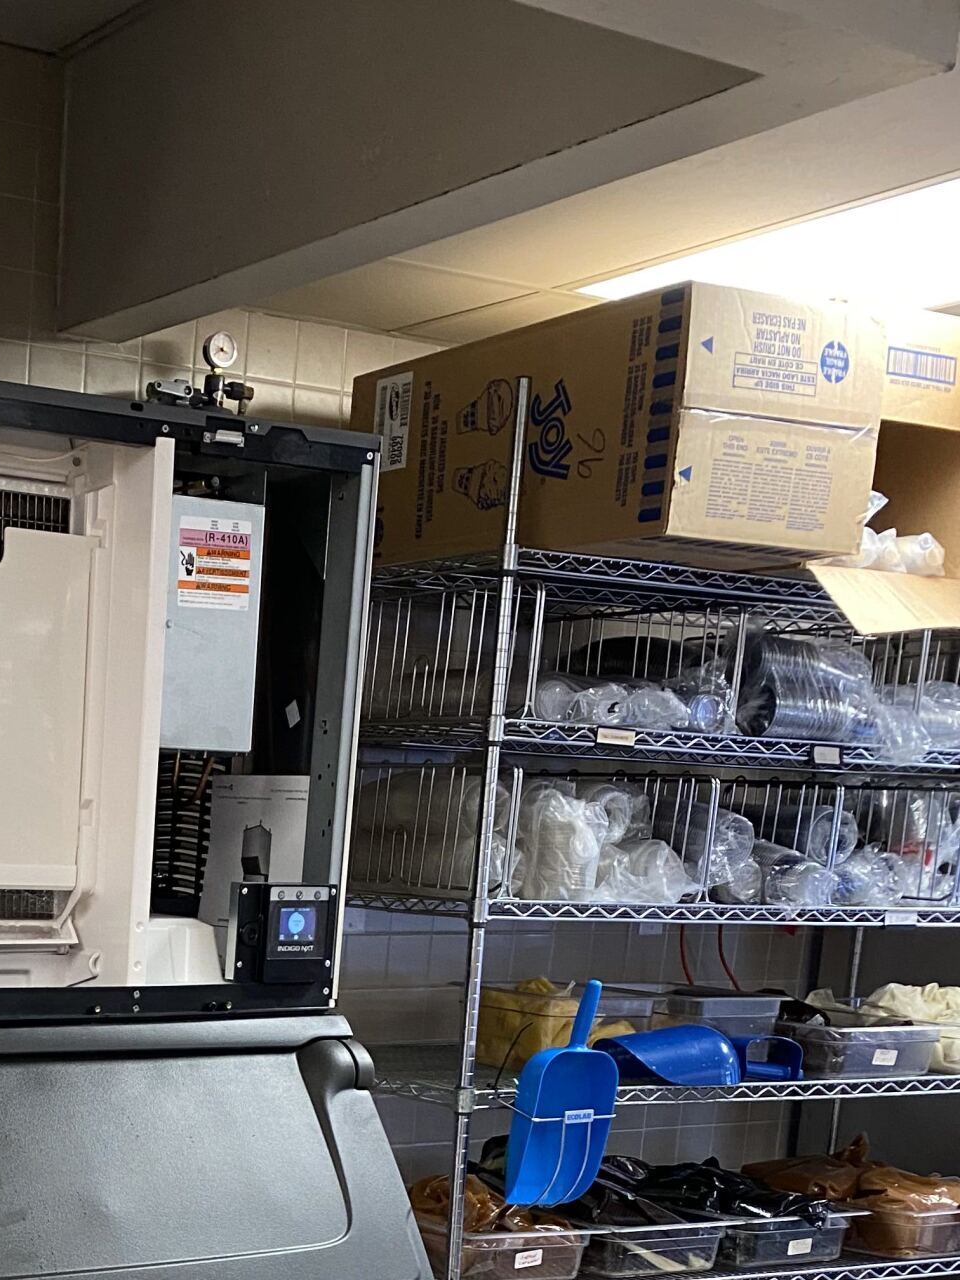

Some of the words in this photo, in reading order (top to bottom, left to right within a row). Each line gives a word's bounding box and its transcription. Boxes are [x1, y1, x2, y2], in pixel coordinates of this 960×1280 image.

[783, 316, 796, 329] PAS
[798, 318, 806, 331] NE
[756, 328, 790, 343] APLASTAR
[791, 333, 801, 345] NO
[753, 341, 776, 355] CRUSH
[777, 344, 790, 357] NOT
[792, 347, 801, 358] DO
[783, 373, 799, 381] LADO
